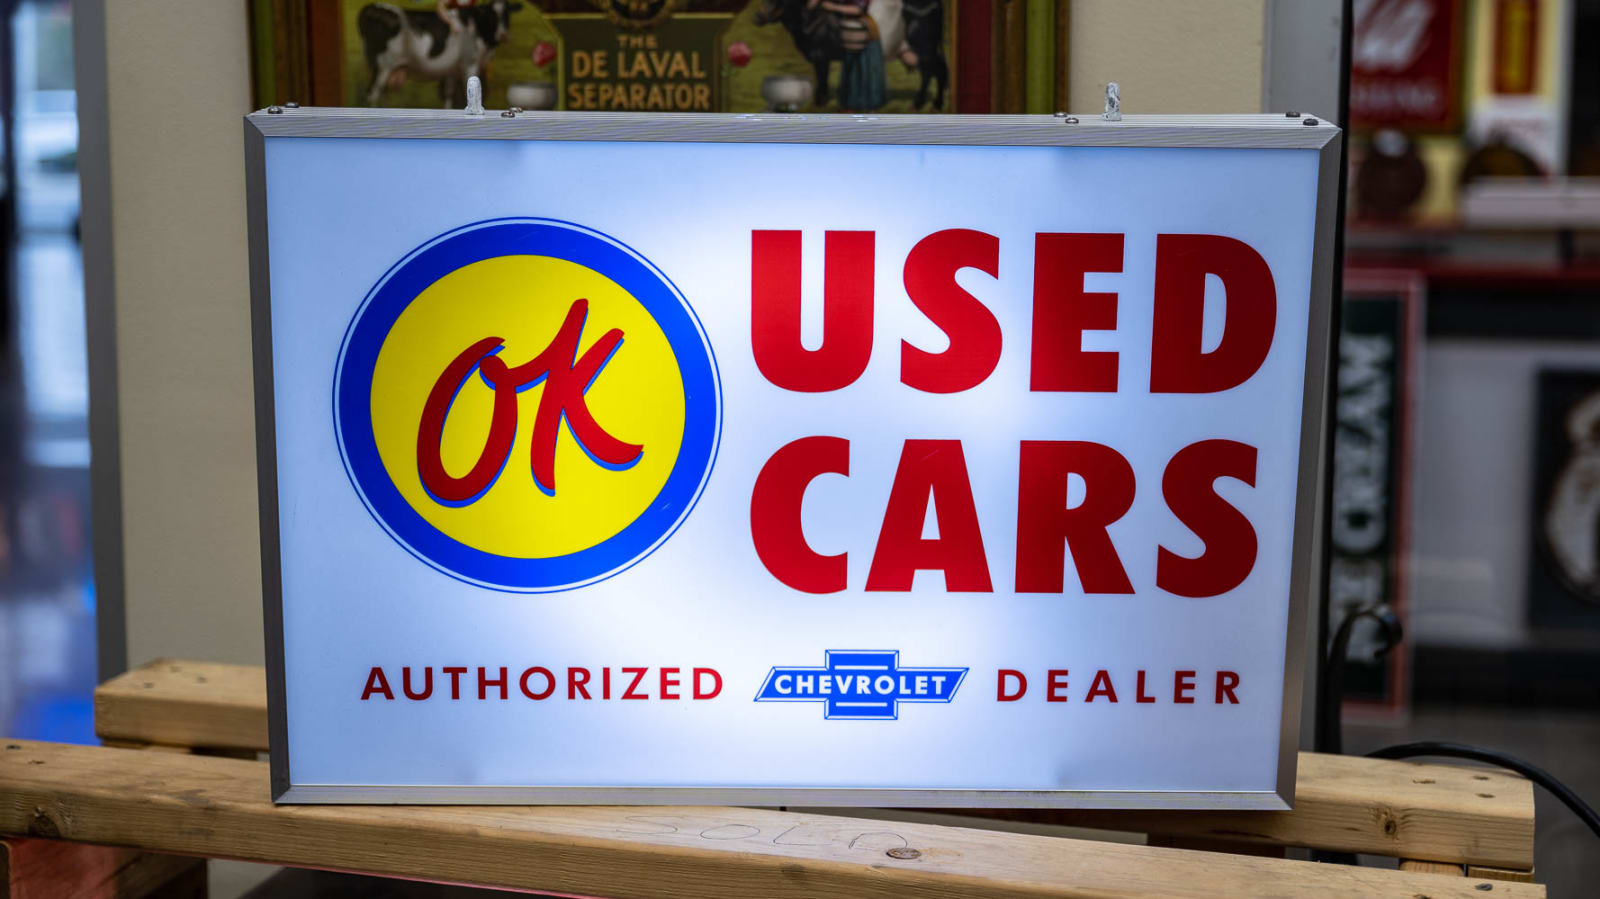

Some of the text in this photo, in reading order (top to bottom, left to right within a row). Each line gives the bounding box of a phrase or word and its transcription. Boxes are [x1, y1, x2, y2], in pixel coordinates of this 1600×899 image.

[618, 34, 658, 48] THE
[572, 51, 706, 79] DE LAVAL
[567, 83, 710, 110] SEPARATOR
[751, 228, 1277, 394] USED
[417, 298, 644, 509] OK
[750, 435, 1258, 599] CARS
[361, 666, 1241, 705] AUTHORIZED CHEVROLET DEALER
